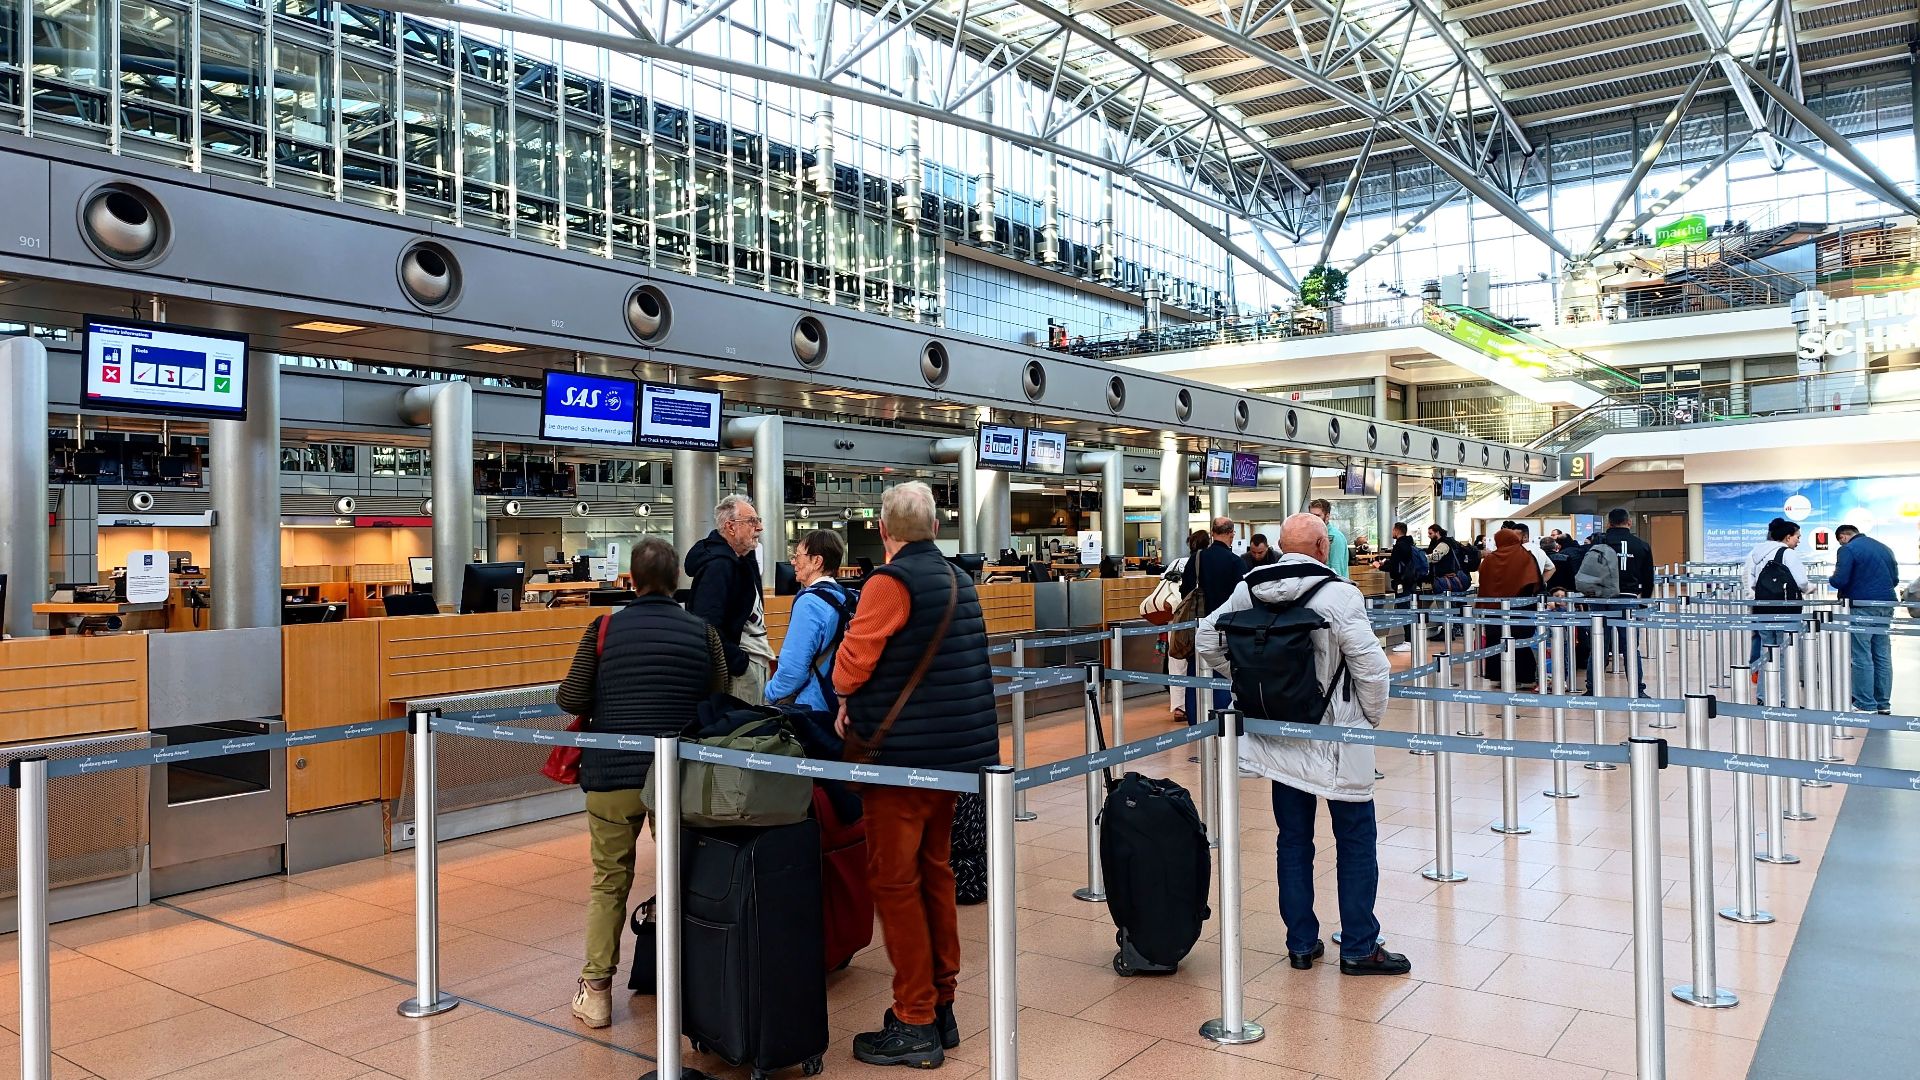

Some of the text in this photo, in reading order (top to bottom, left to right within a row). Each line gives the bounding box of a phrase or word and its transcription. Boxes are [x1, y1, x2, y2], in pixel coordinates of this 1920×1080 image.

[1658, 223, 1703, 239] marché
[19, 236, 40, 248] 901
[551, 319, 564, 328] 902
[560, 386, 602, 408] SAS
[1572, 456, 1585, 473] 9
[1832, 716, 1853, 724] Hamburg
[1279, 726, 1312, 735] Hamburg Airport
[1341, 732, 1375, 741] Hamburg Airport
[222, 741, 256, 750] Hamburg Airport
[1406, 738, 1442, 747] Hamburg Airport
[1476, 743, 1513, 753] Hamburg Airport
[154, 749, 190, 760] Hamburg Airport
[1550, 748, 1590, 759] Hamburg Airport
[79, 758, 118, 768] Hamburg Airport
[1724, 758, 1769, 771] Hamburg Airport
[1814, 767, 1862, 780] Hamburg Airport
